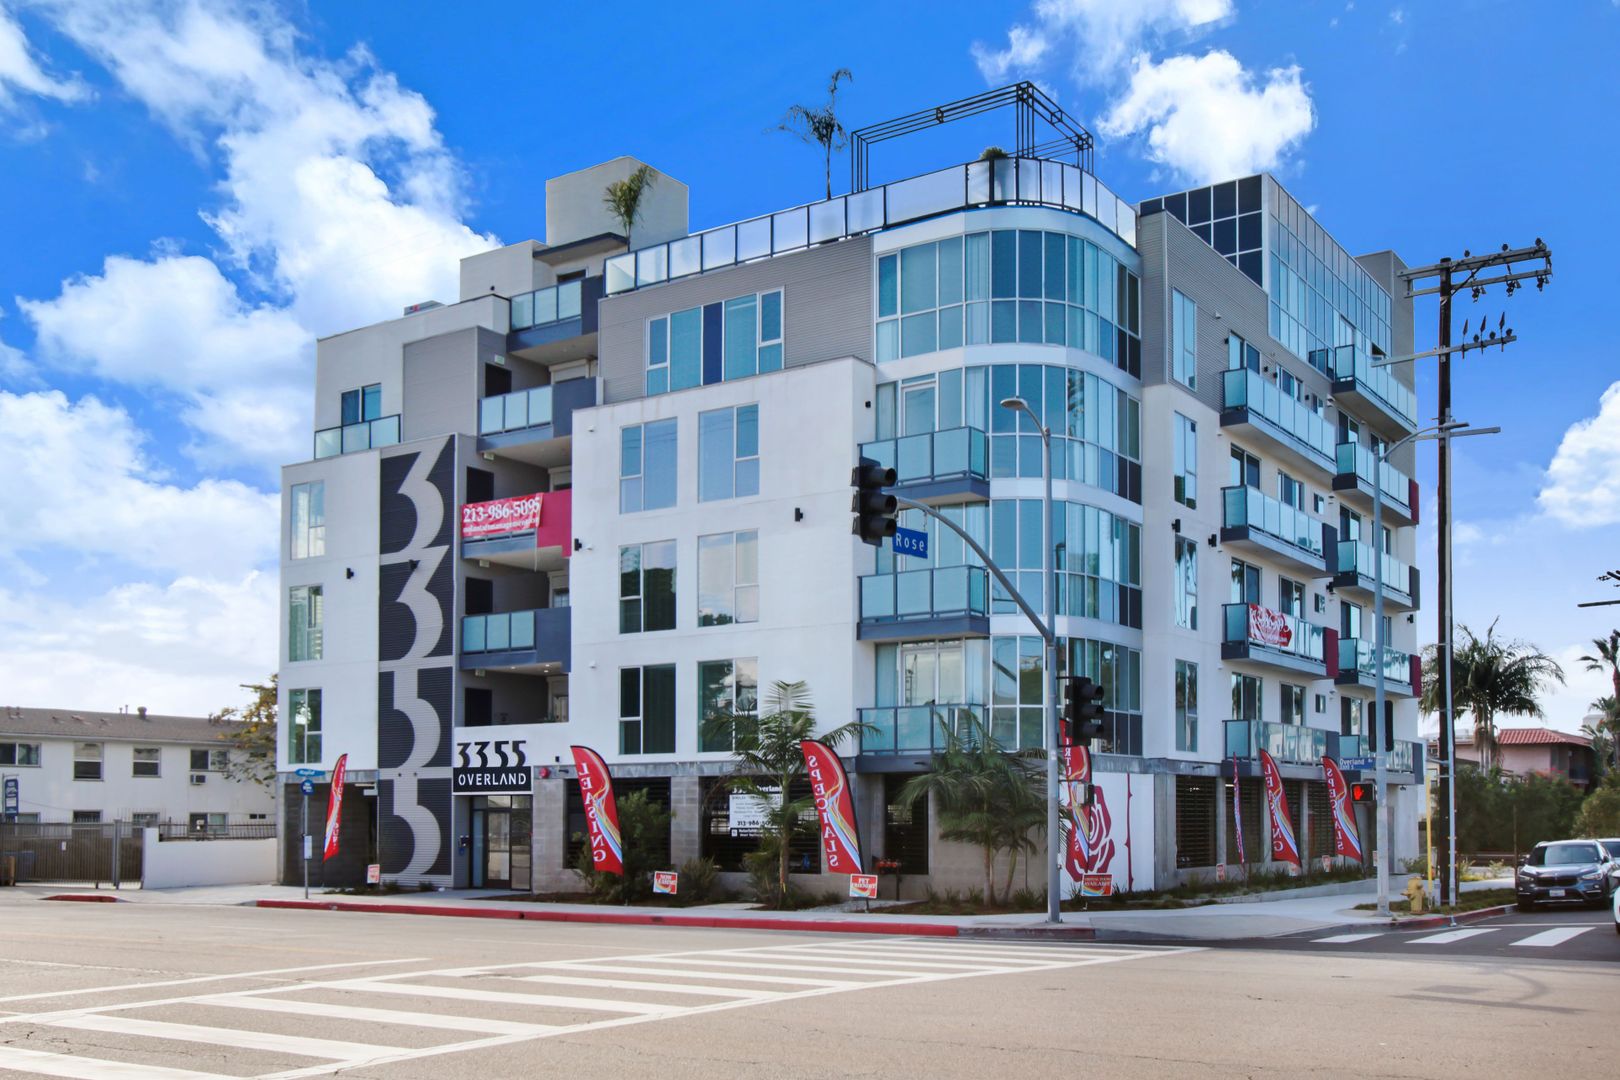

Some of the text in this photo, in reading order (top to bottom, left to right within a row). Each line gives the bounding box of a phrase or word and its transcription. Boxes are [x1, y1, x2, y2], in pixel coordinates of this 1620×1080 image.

[895, 532, 925, 552] Rose
[457, 740, 527, 768] 3355
[458, 773, 527, 786] OVERLAND
